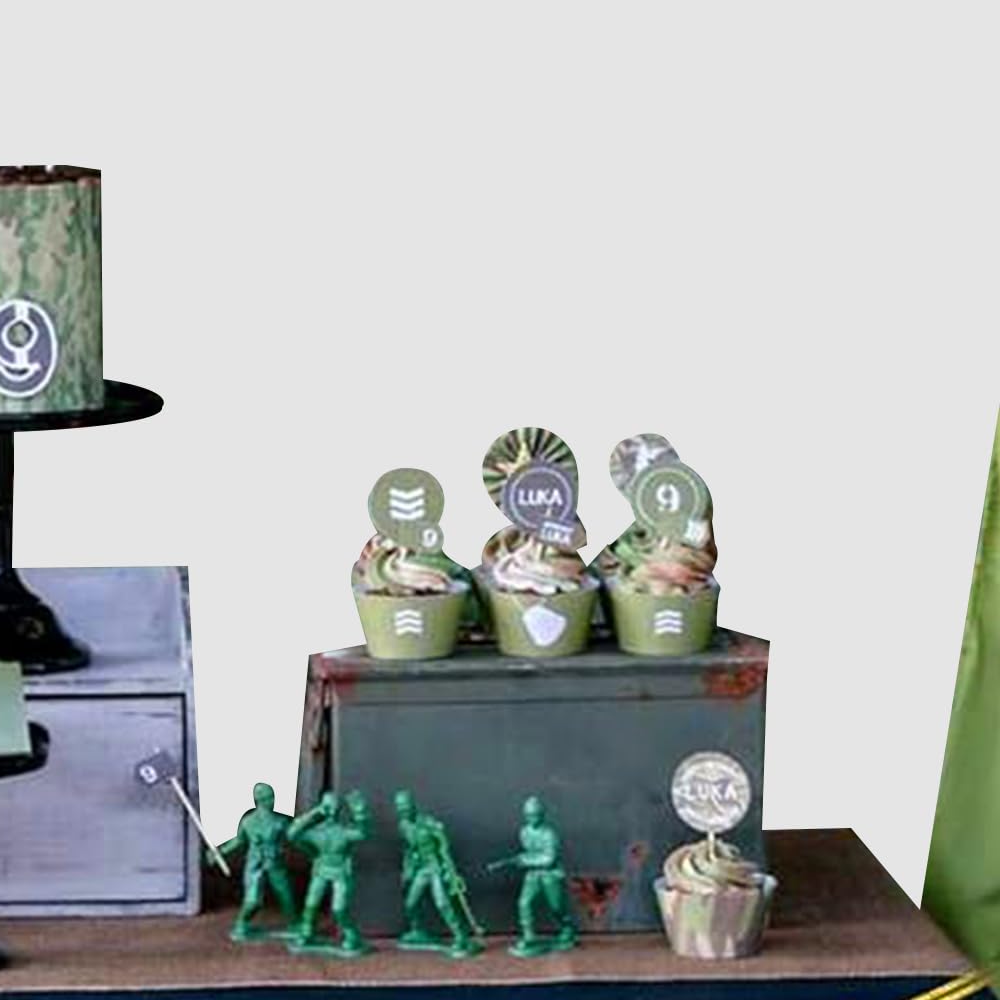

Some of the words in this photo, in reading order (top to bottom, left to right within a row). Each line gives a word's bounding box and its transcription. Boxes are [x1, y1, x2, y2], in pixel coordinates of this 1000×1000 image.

[518, 488, 563, 506] LUKA
[656, 484, 680, 512] 9
[683, 783, 737, 801] LUKA
